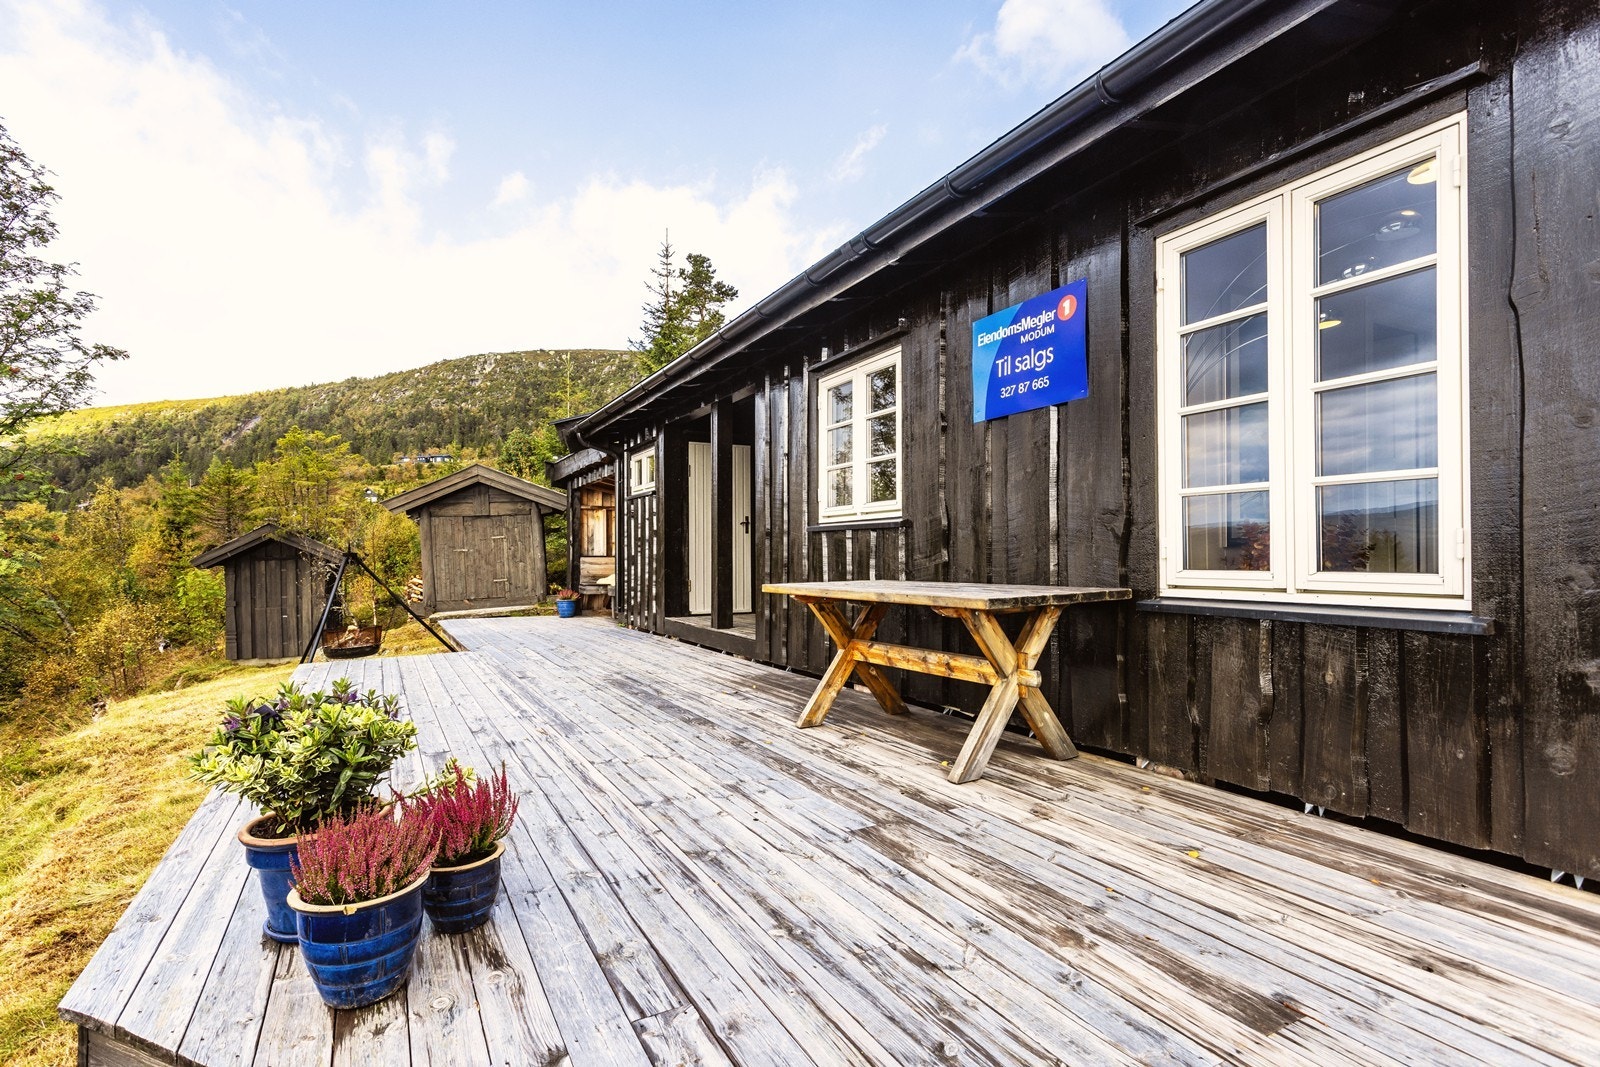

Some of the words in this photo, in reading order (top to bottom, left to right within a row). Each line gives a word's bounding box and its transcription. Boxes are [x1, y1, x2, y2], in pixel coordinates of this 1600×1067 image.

[977, 309, 1056, 347] EiendomsMegler
[1062, 299, 1071, 316] 1
[1020, 324, 1055, 344] MODUM
[996, 355, 1011, 378] Til
[1015, 347, 1054, 371] salgs
[1000, 384, 1016, 399] 327
[1018, 381, 1030, 394] 87
[1032, 376, 1050, 390] 665
